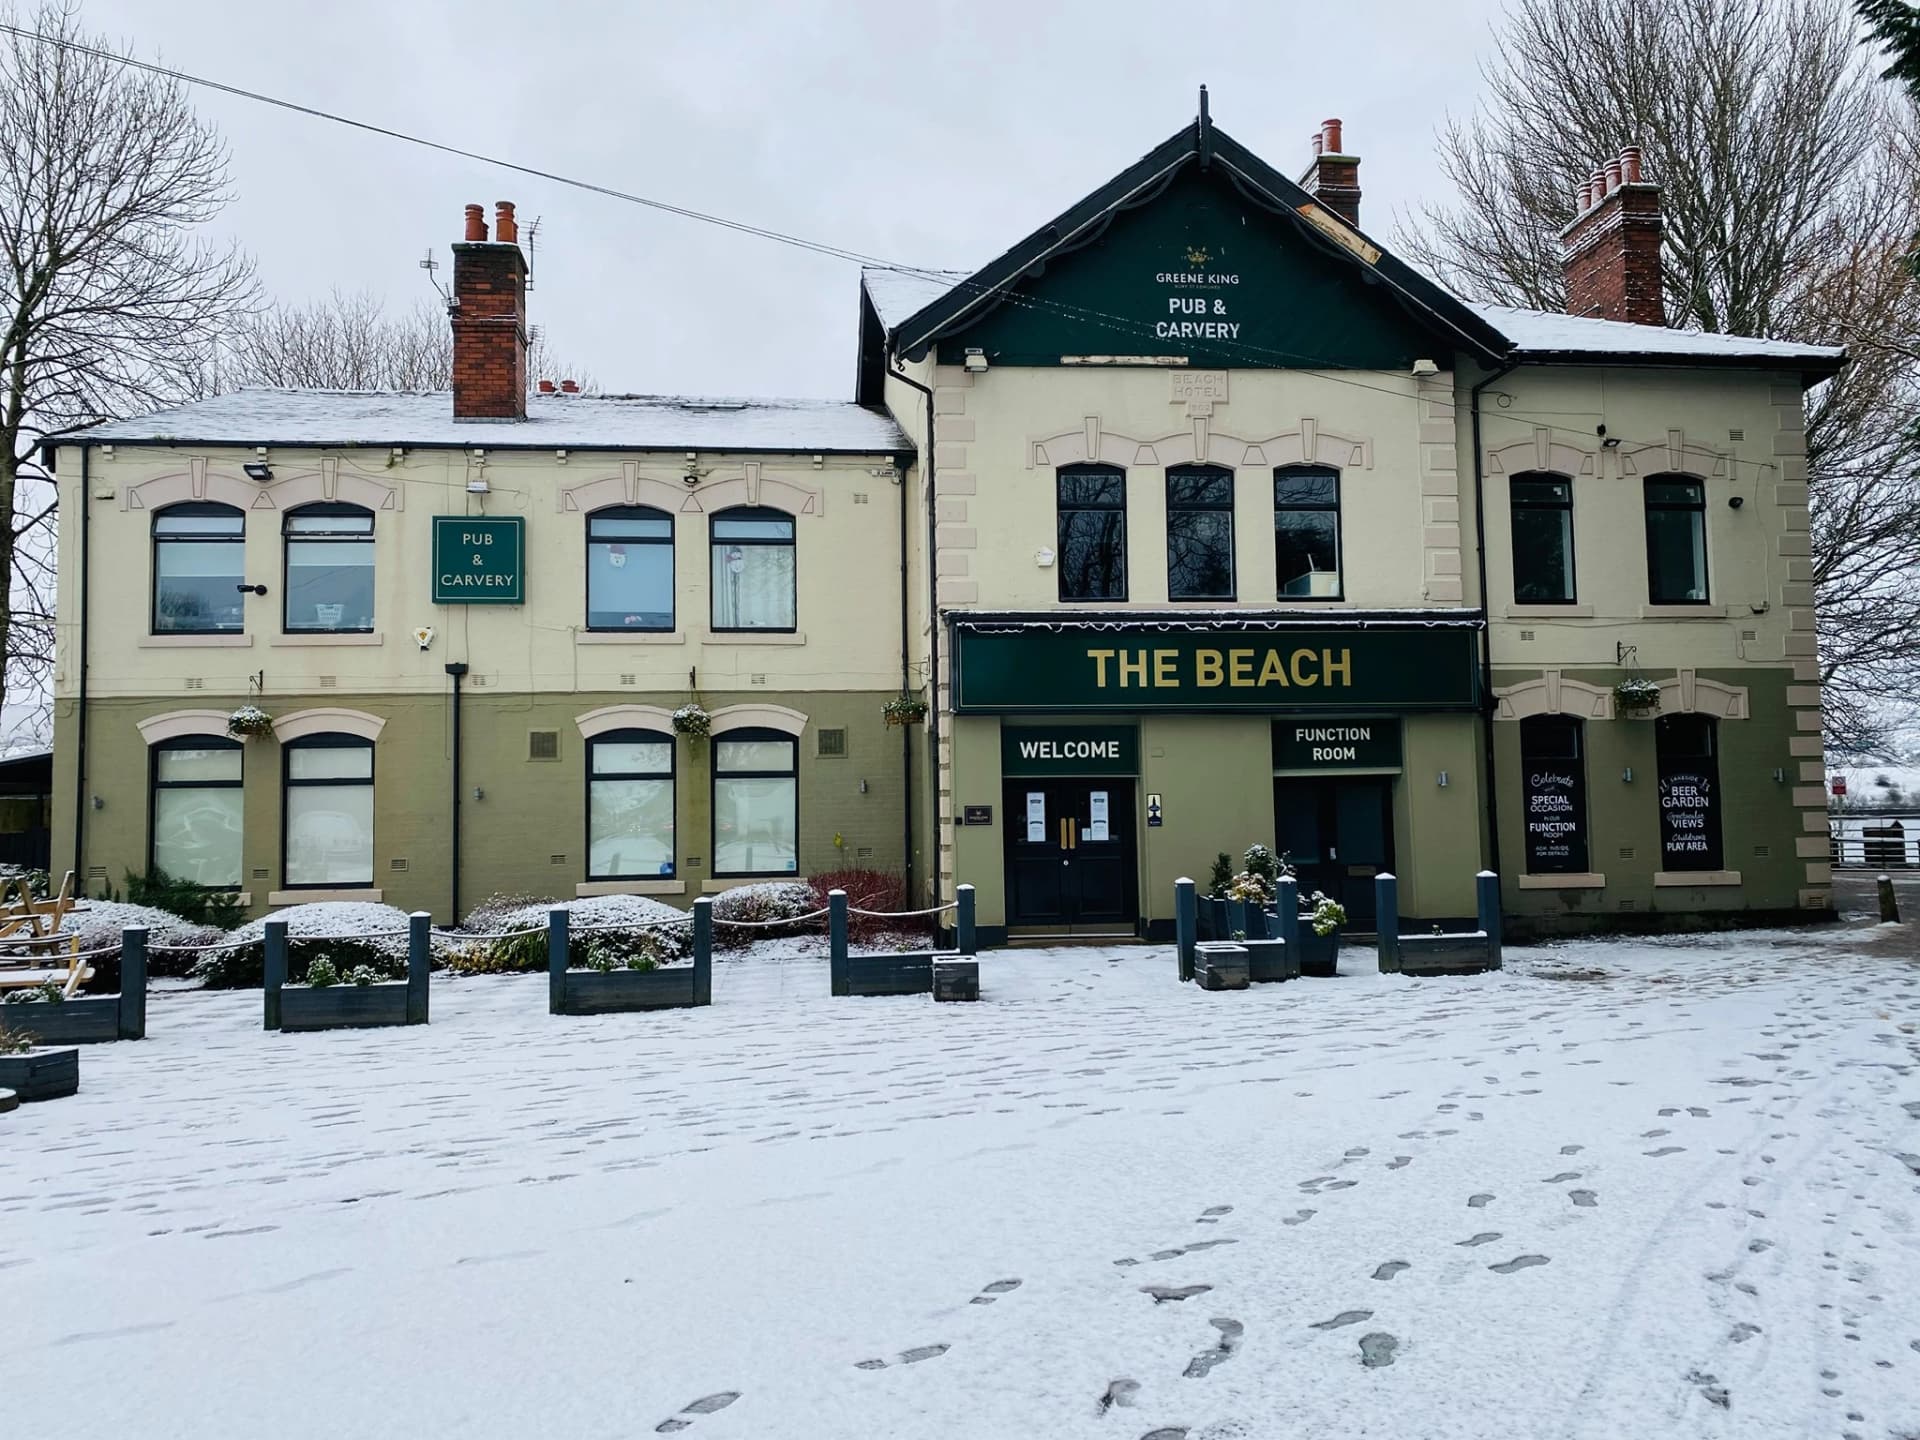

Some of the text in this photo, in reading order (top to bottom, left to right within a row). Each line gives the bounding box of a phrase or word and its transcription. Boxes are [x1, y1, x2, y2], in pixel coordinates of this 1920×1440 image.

[1156, 273, 1239, 284] GREENE KING
[1169, 298, 1227, 315] PUB &
[1156, 322, 1240, 338] CARVERY
[1173, 374, 1224, 384] BEACH
[1174, 387, 1222, 397] HOTEL
[463, 533, 493, 545] PUB
[472, 554, 483, 565] &
[441, 574, 513, 586] CARVERY
[1087, 649, 1352, 687] THE BEACH
[1296, 728, 1371, 742] FUNCTION
[1020, 741, 1120, 758] WELCOME
[1313, 747, 1356, 760] ROOM
[1531, 771, 1574, 787] Celebrate
[1671, 786, 1698, 796] BEER
[1531, 795, 1569, 804] SPECIAL
[1662, 797, 1709, 807] GARDEN
[1530, 804, 1573, 812] OCCASION
[1530, 822, 1576, 832] FUNCTION
[1671, 819, 1704, 828] VIEWS
[1667, 842, 1708, 852] PLAY AREA
